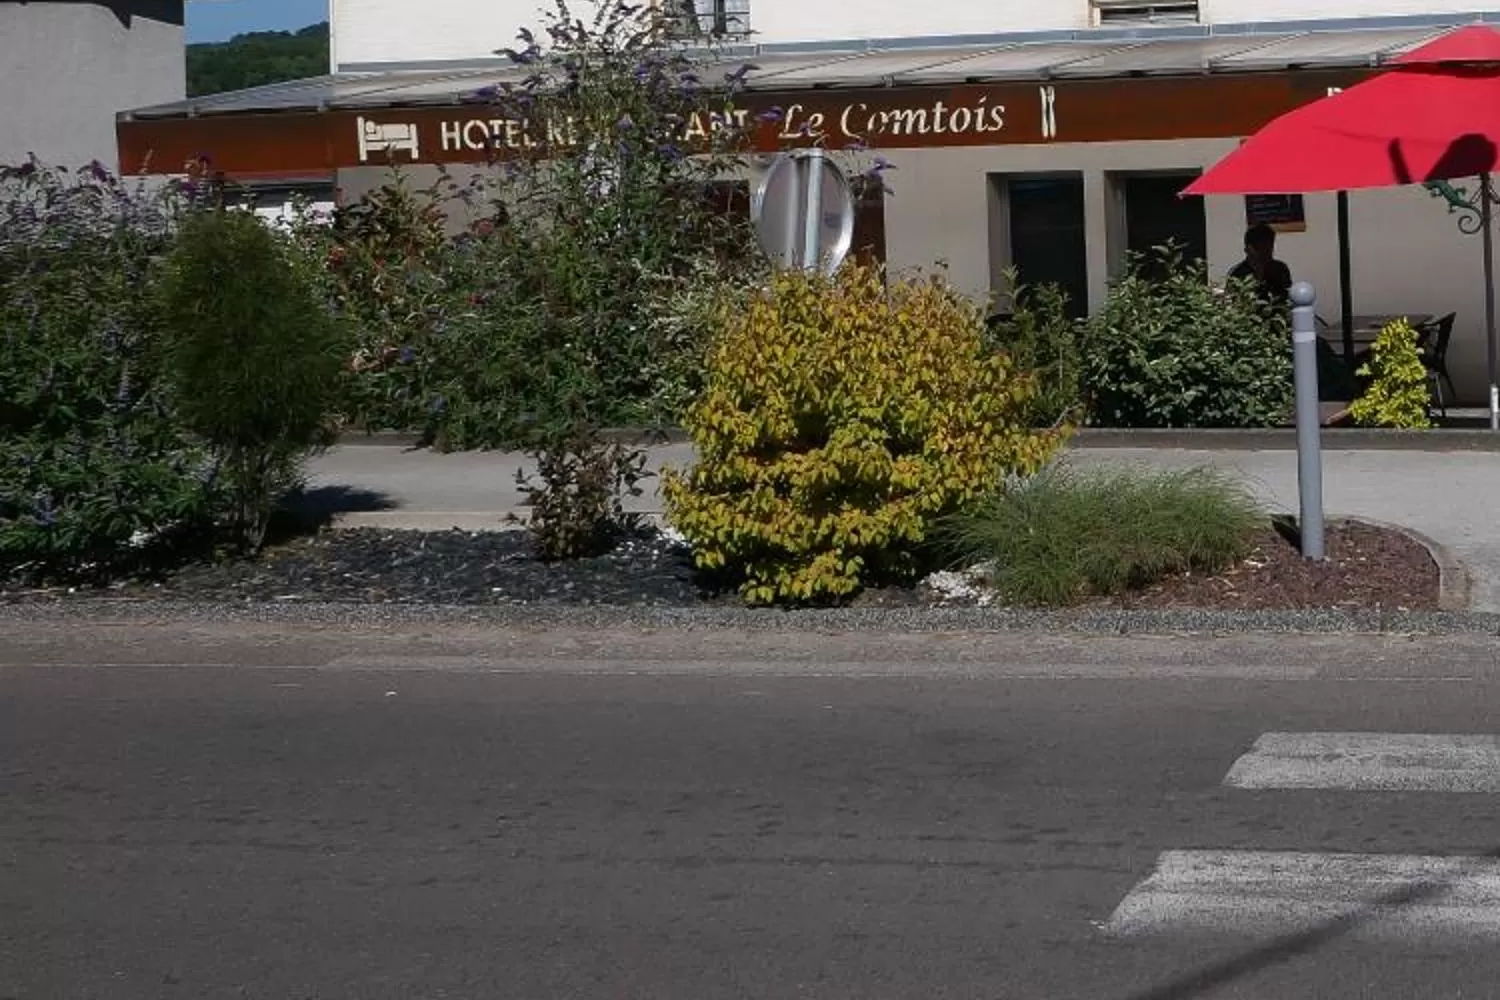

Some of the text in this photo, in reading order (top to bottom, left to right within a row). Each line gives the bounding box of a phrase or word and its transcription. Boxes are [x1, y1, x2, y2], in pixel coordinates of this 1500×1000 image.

[440, 118, 538, 151] HOTEL
[778, 103, 825, 140] Le
[840, 96, 1005, 139] Comtois
